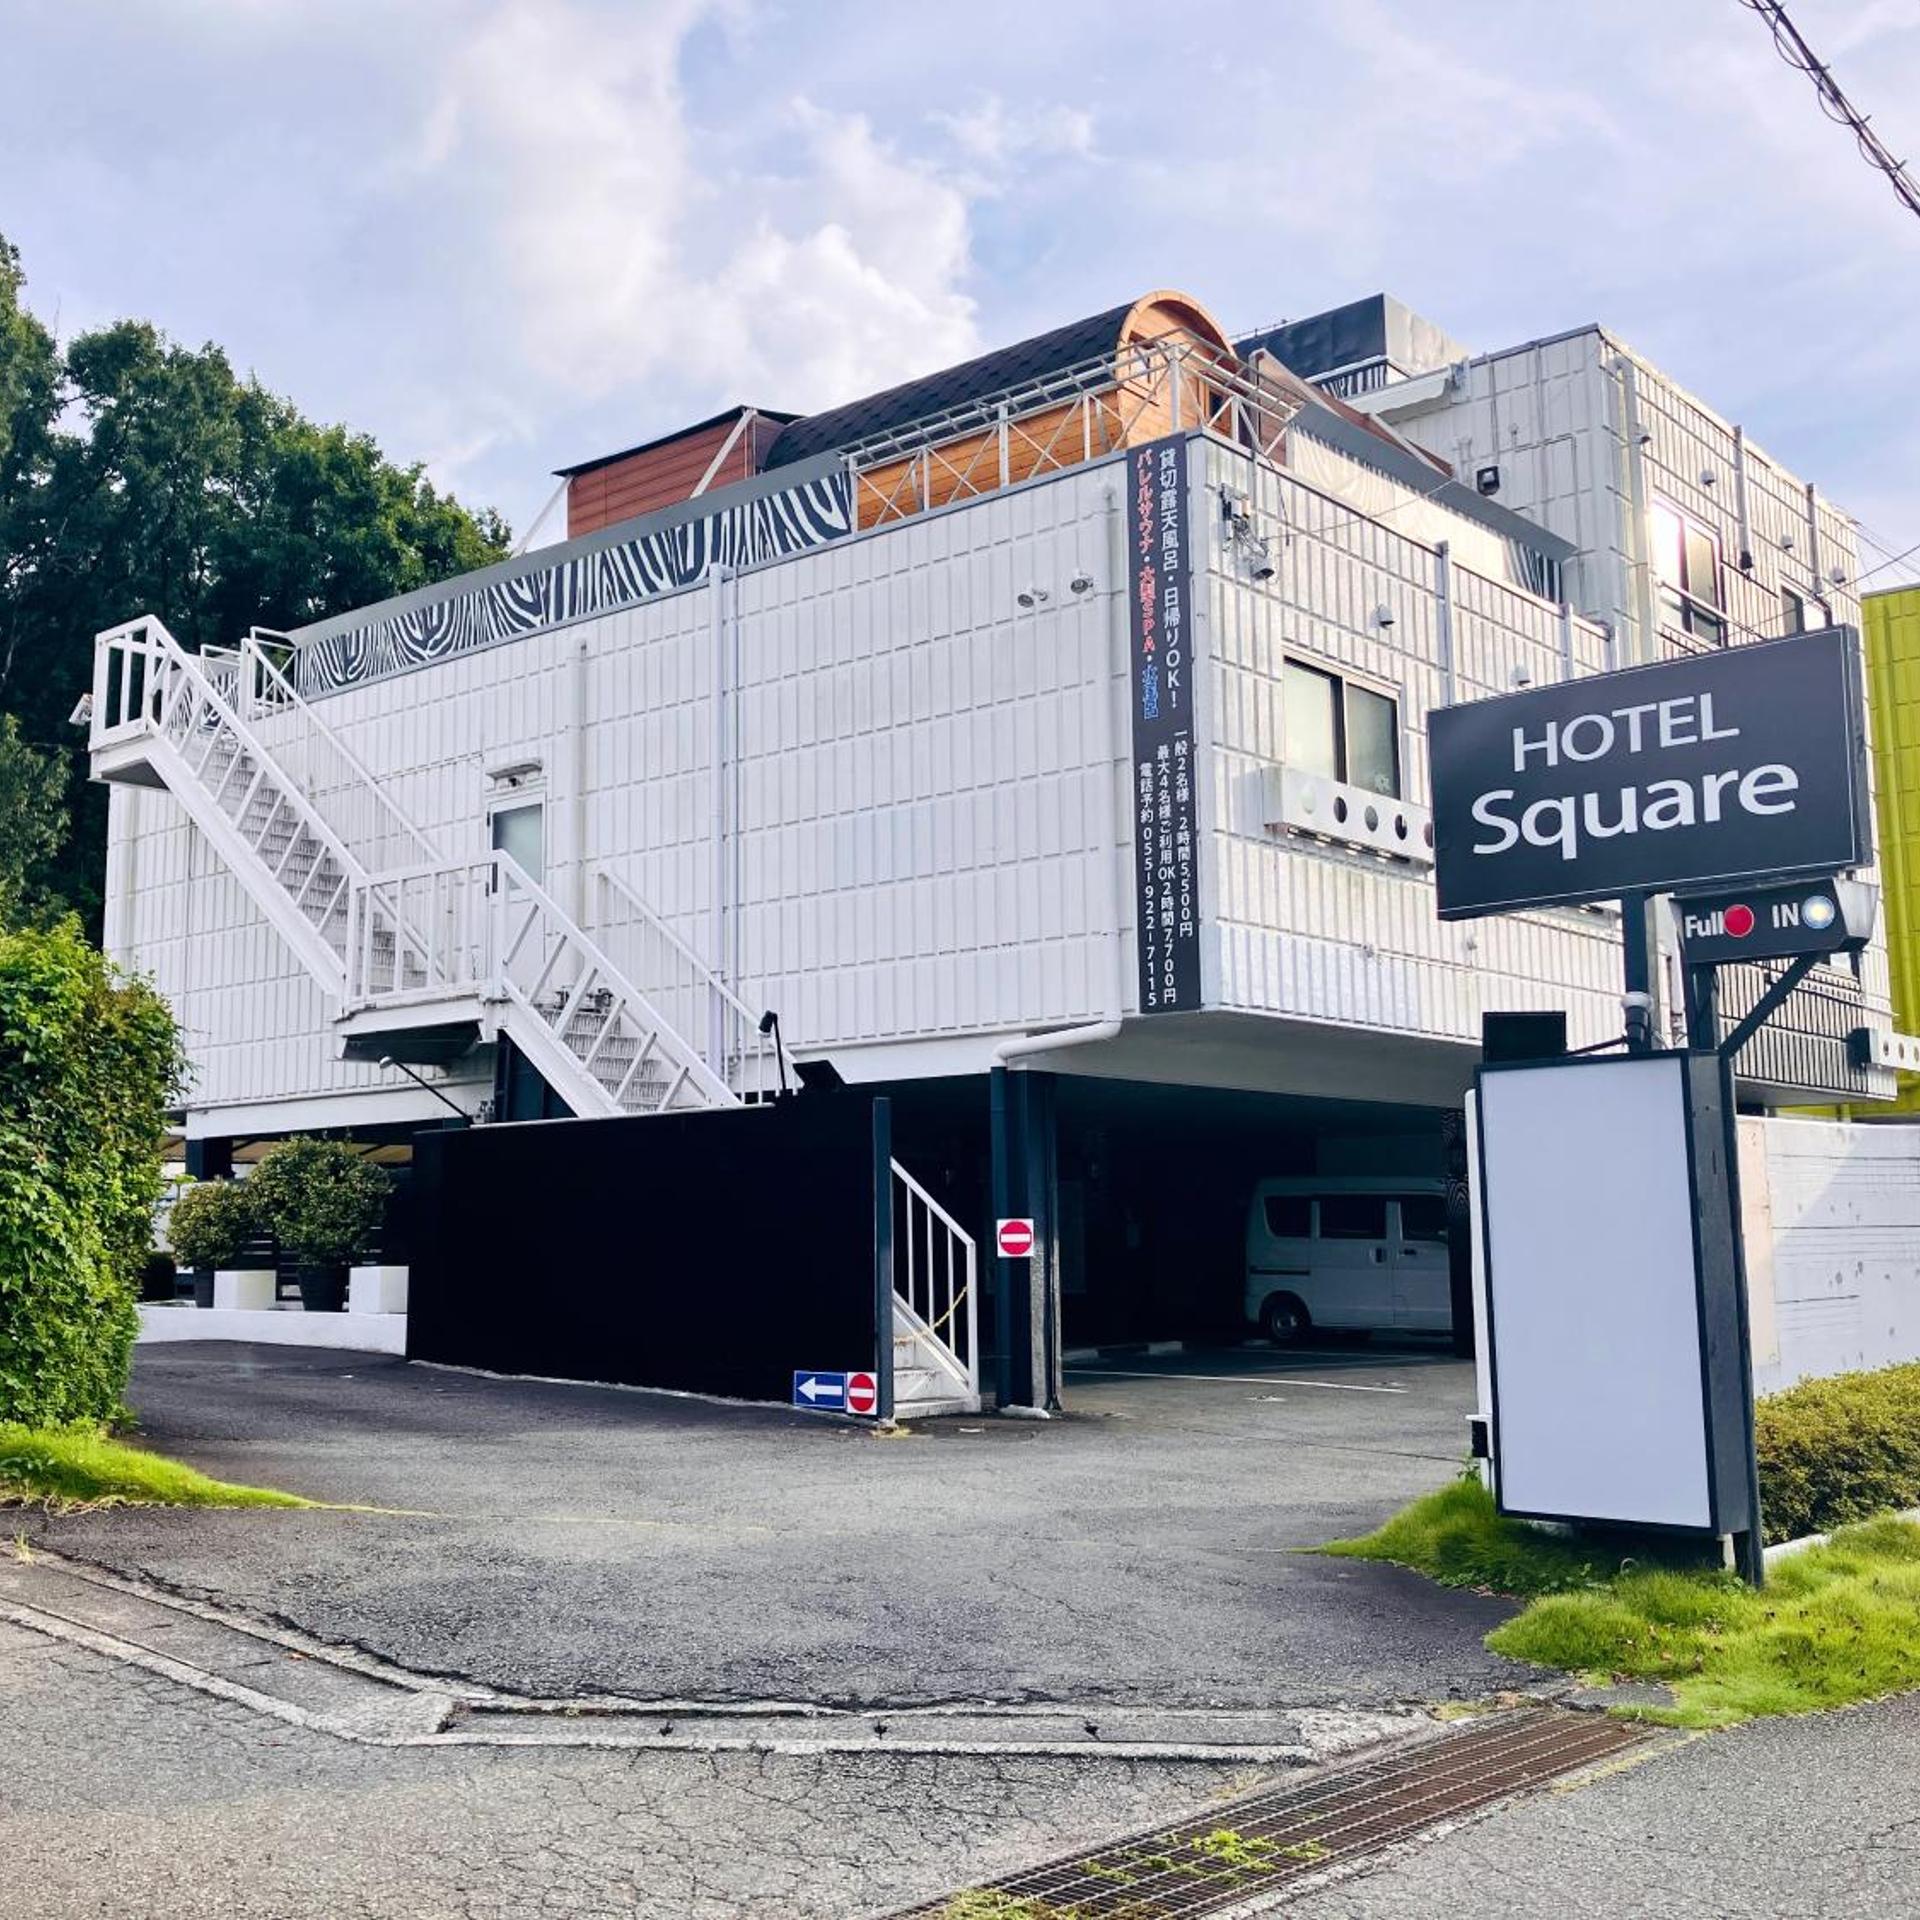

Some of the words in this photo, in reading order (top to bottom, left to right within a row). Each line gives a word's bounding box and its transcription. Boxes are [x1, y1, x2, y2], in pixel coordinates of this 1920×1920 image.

[1512, 693, 1740, 772] HOTEL
[1471, 764, 1799, 859] Square
[1685, 912, 1725, 938] Full
[1772, 902, 1799, 928] IN
